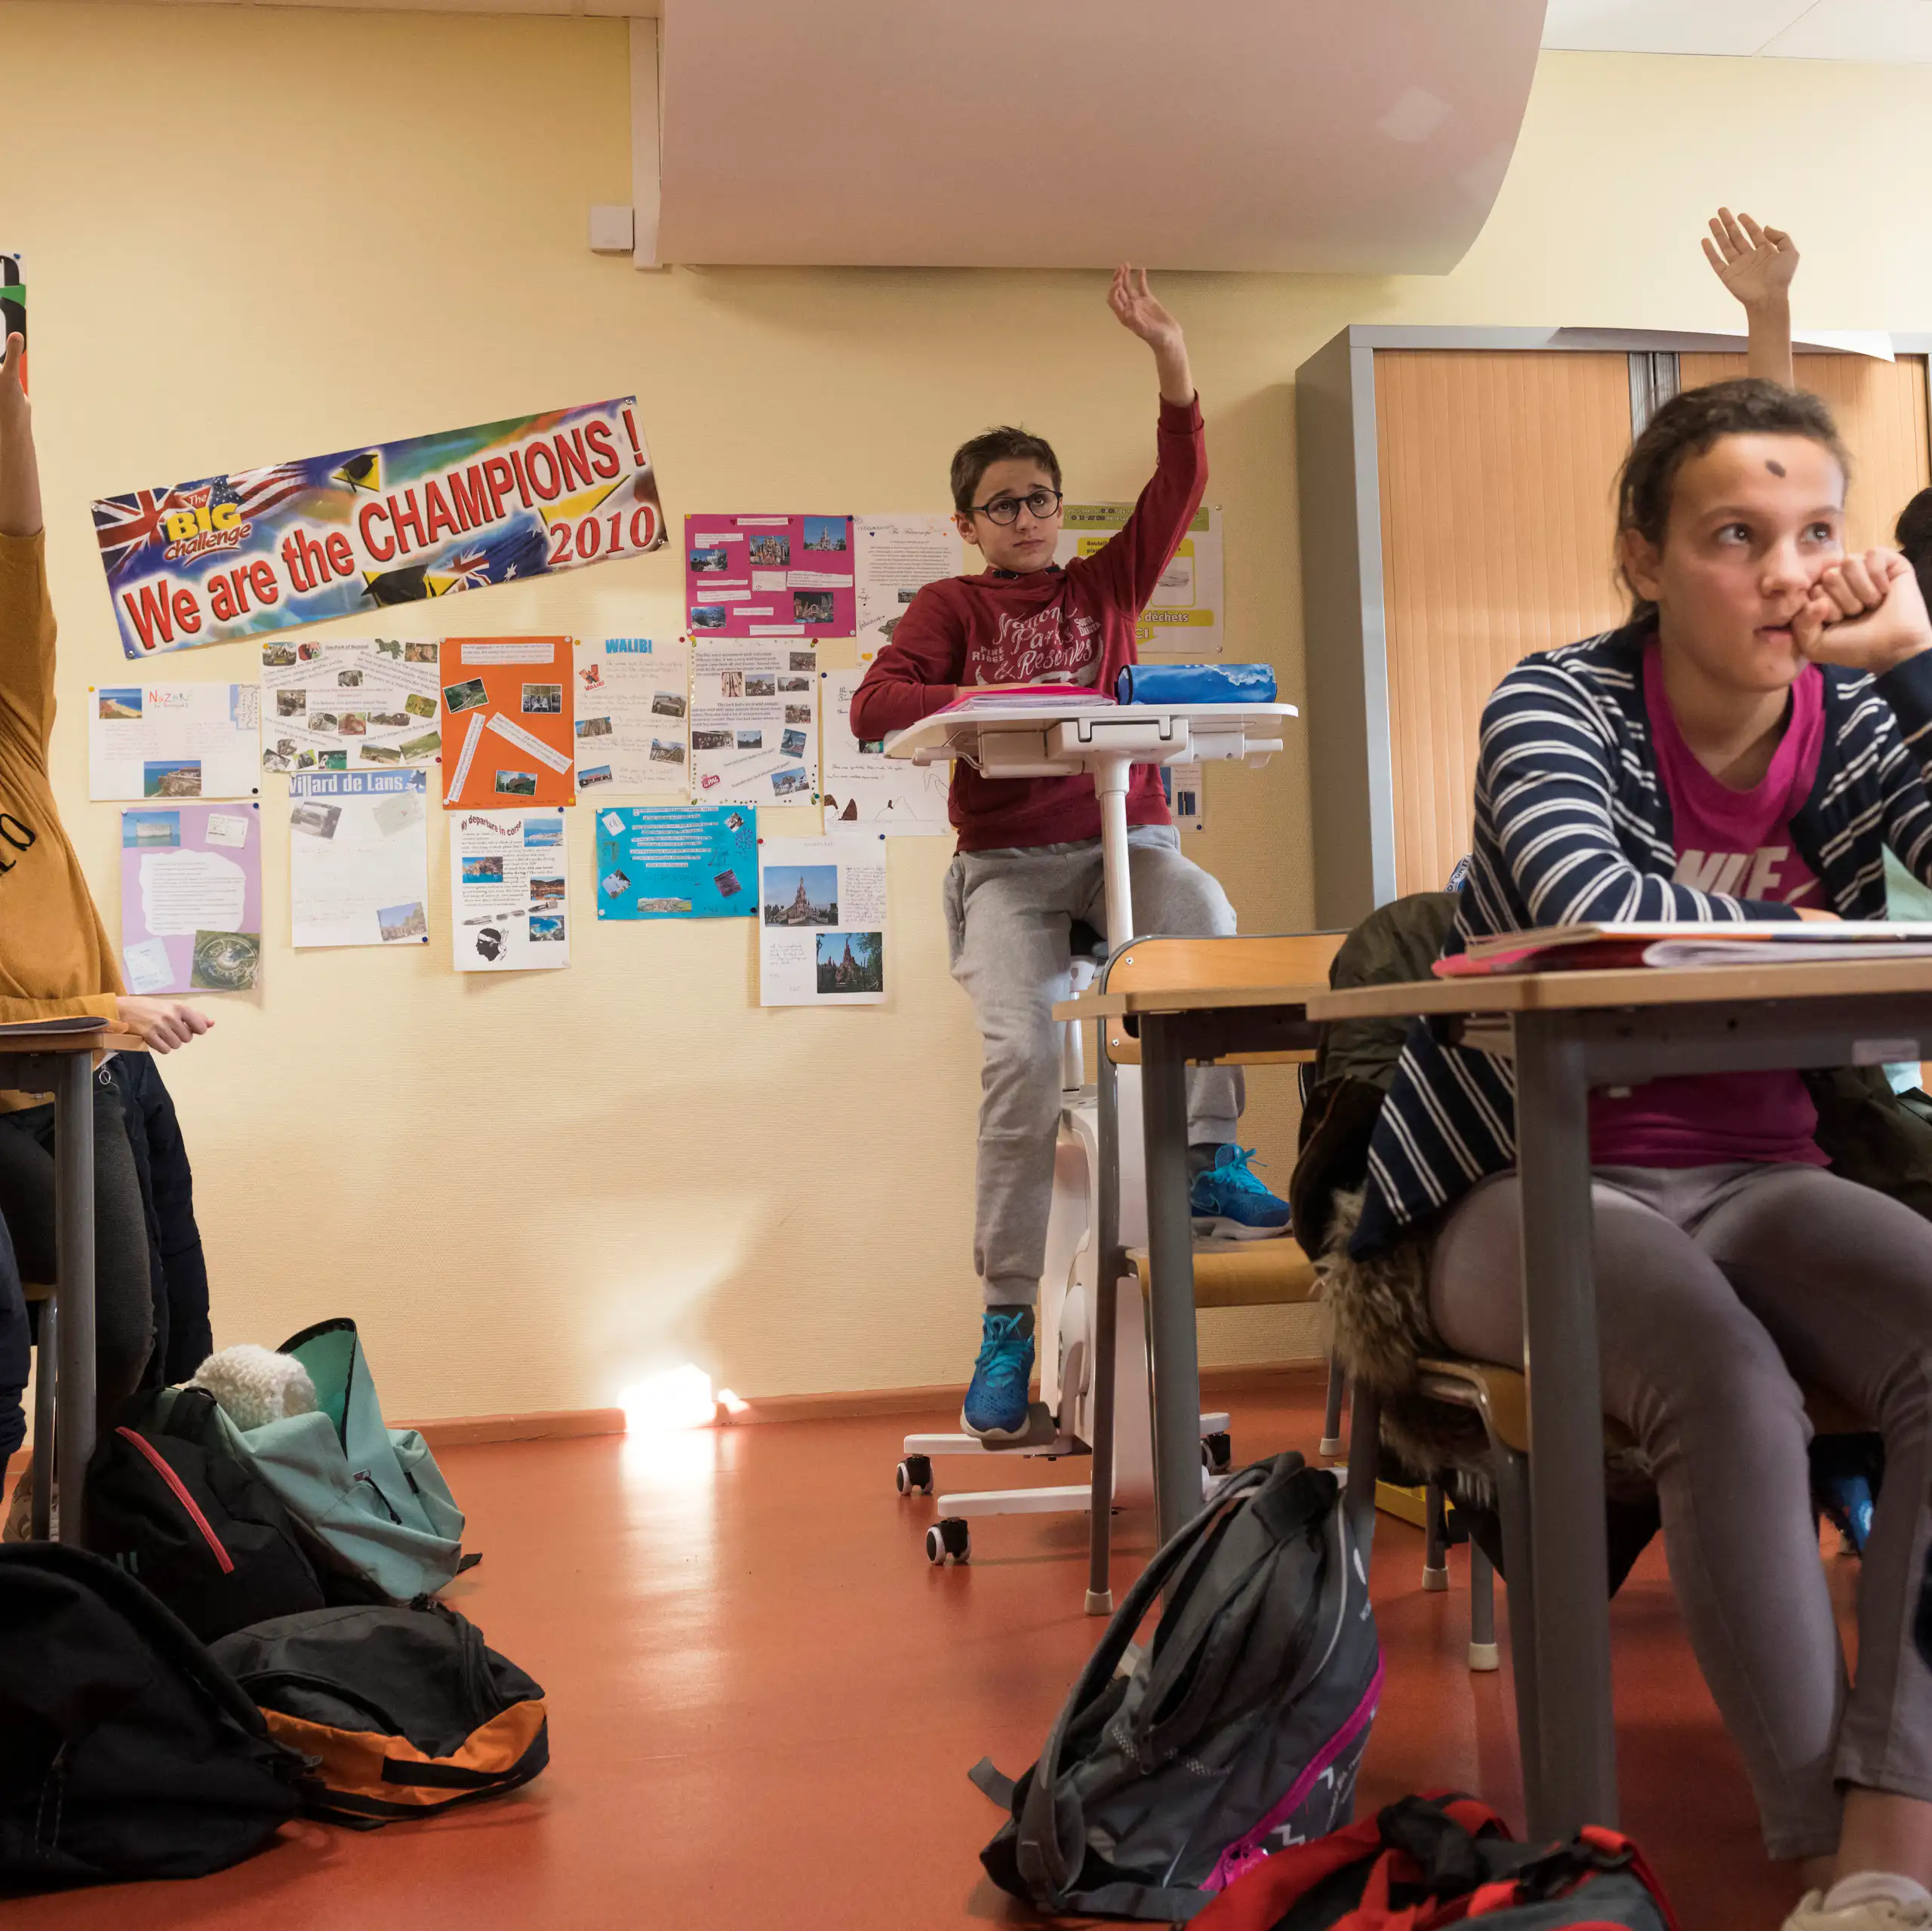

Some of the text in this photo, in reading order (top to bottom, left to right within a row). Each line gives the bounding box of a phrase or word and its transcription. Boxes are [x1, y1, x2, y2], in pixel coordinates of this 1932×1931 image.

[189, 494, 207, 506] The
[122, 409, 646, 650] We are the CHAMPIONS !
[167, 503, 242, 543] BIG
[164, 524, 251, 561] challenge
[548, 506, 656, 565] 2010
[1144, 611, 1189, 623] déchets
[605, 638, 653, 654] WALIBI
[971, 650, 1005, 663] RIDGE
[980, 645, 1004, 655] PINE
[1017, 636, 1093, 680] Reserves
[584, 681, 605, 691] WALIBI
[288, 773, 404, 797] Villard de Lans
[708, 776, 719, 786] PAL
[468, 814, 498, 832] departure
[499, 825, 506, 836] in
[1672, 845, 1789, 901] NIE
